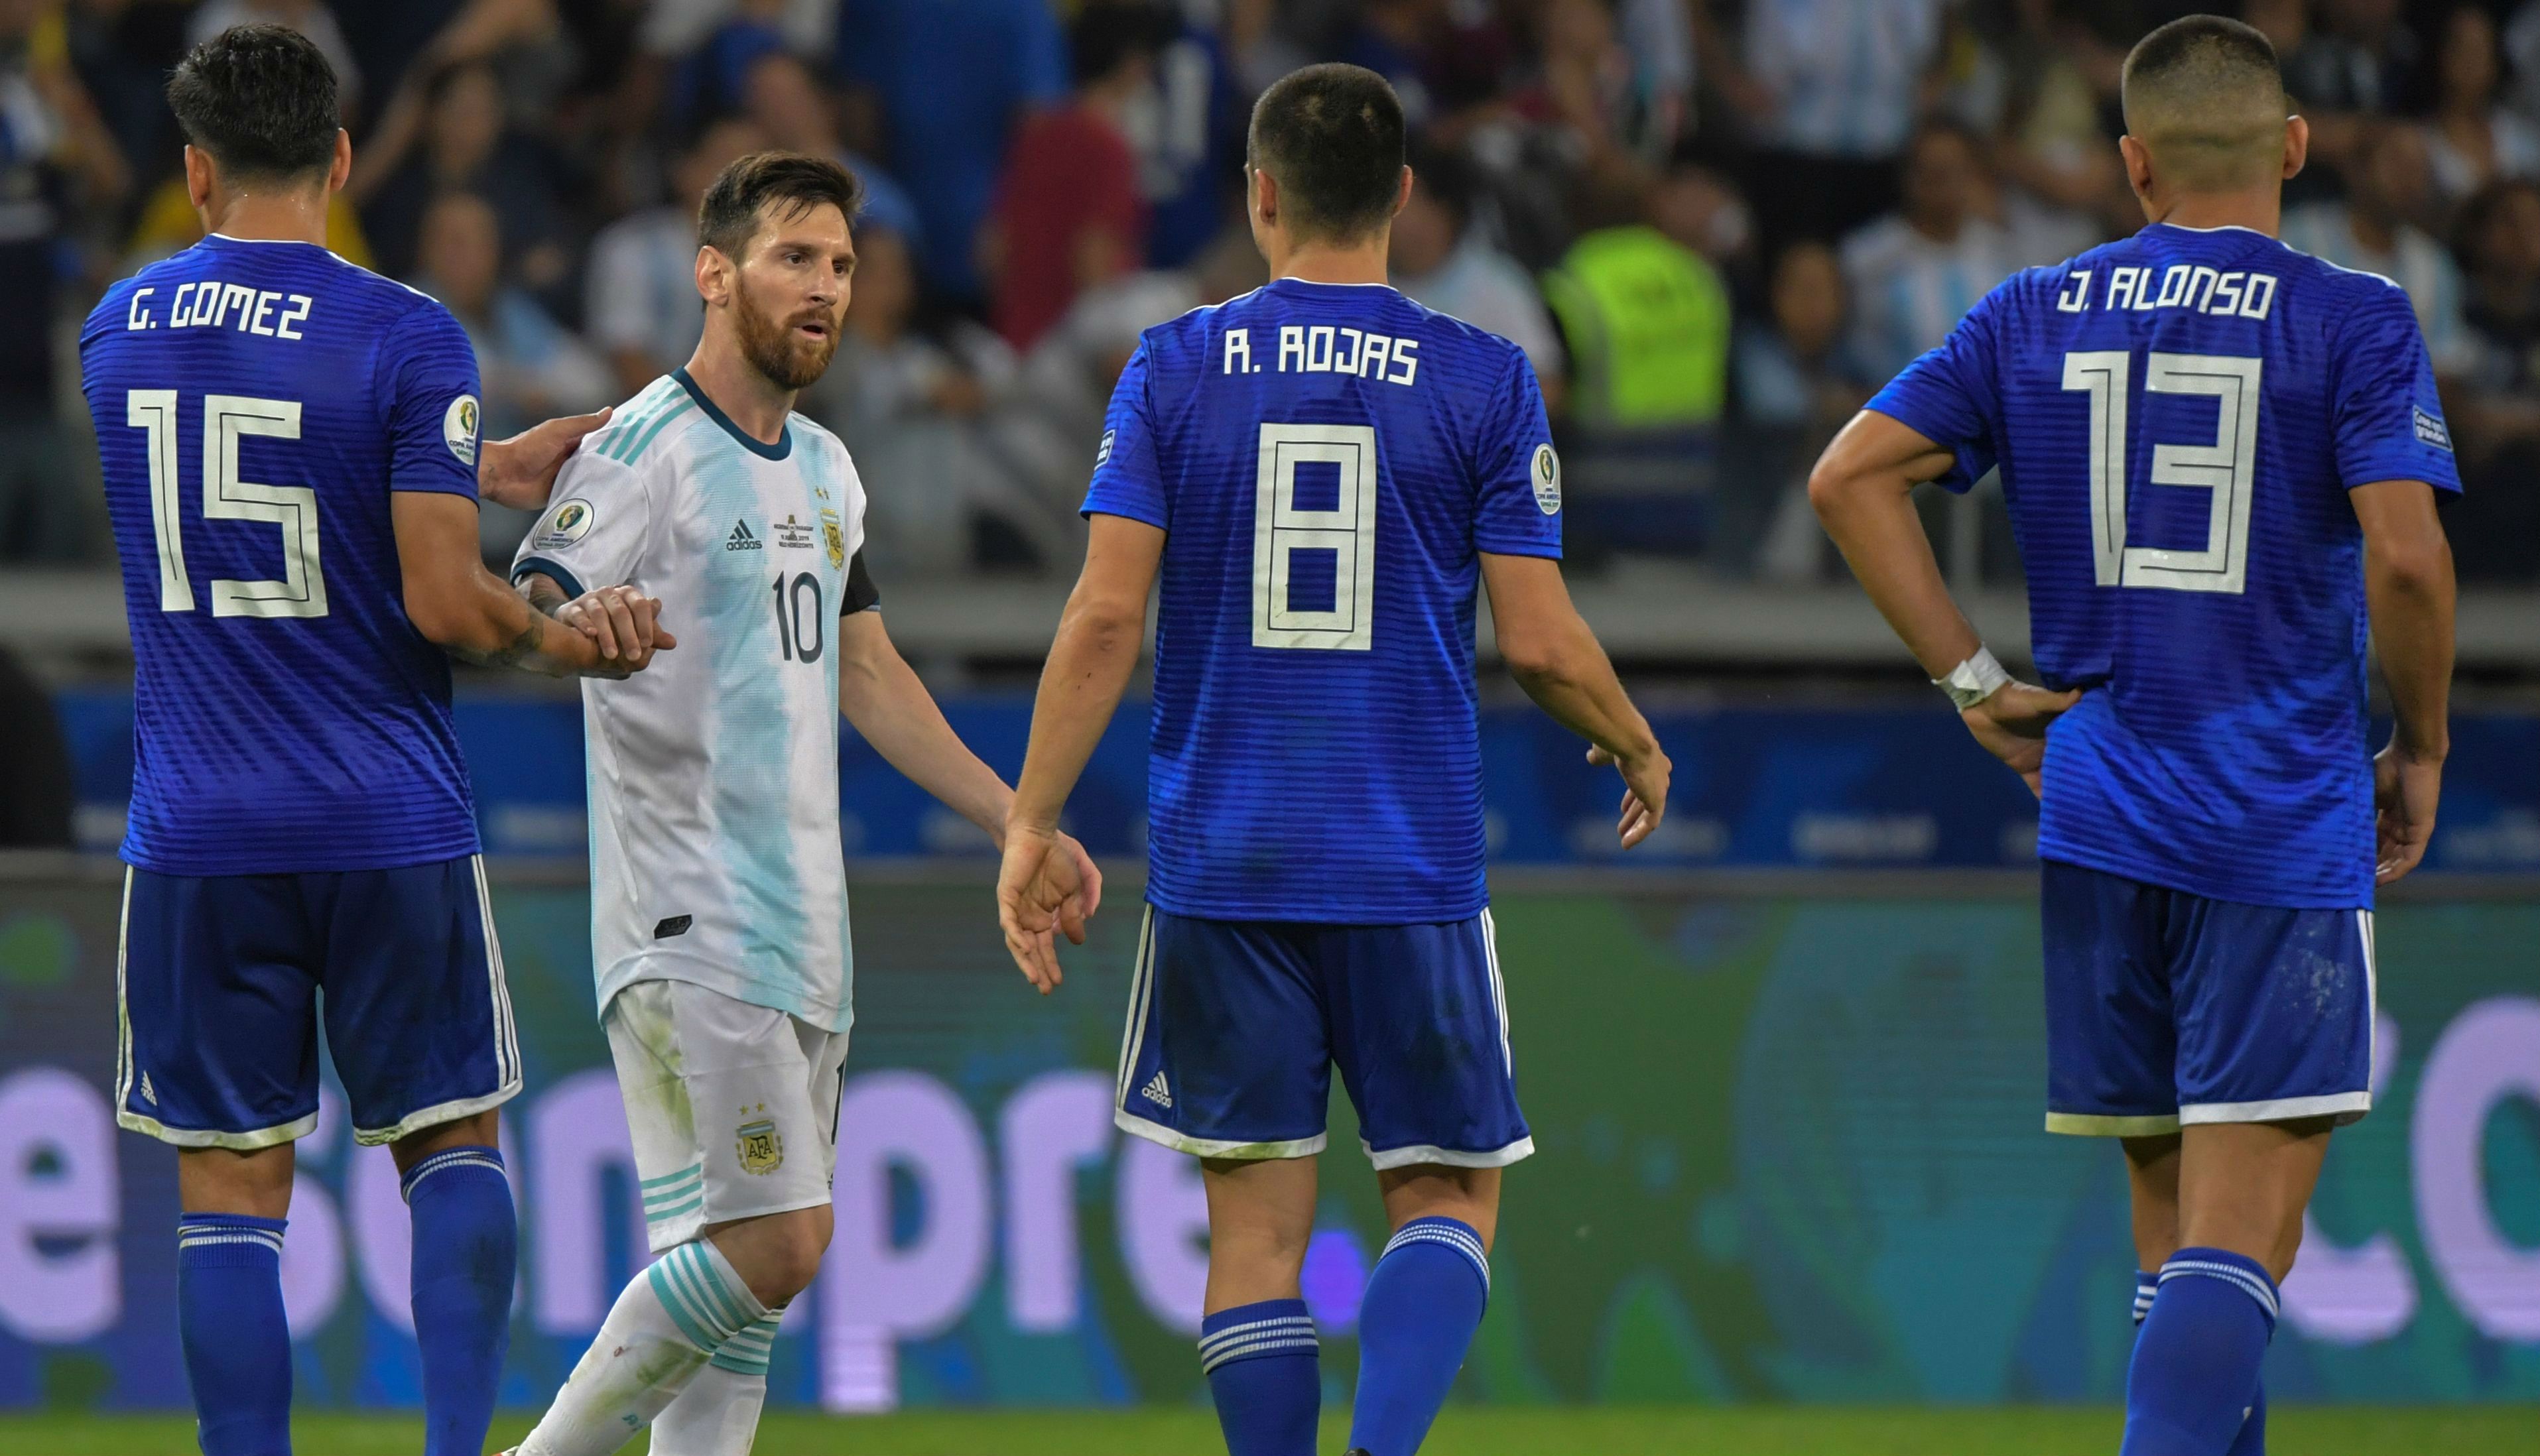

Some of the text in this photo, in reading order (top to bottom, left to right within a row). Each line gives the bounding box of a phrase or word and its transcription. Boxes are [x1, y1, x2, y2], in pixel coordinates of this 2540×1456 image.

[128, 282, 312, 340] G. GOMEZ
[2057, 265, 2277, 320] J. ALONSO
[1224, 326, 1419, 386] R. ROJAS
[2061, 351, 2263, 595] 13
[127, 389, 329, 617] 15
[726, 538, 763, 551] adidas
[1252, 422, 1375, 650] 8
[772, 571, 824, 664] 10
[1141, 1086, 1173, 1109] adidas
[748, 1136, 773, 1160] AFA
